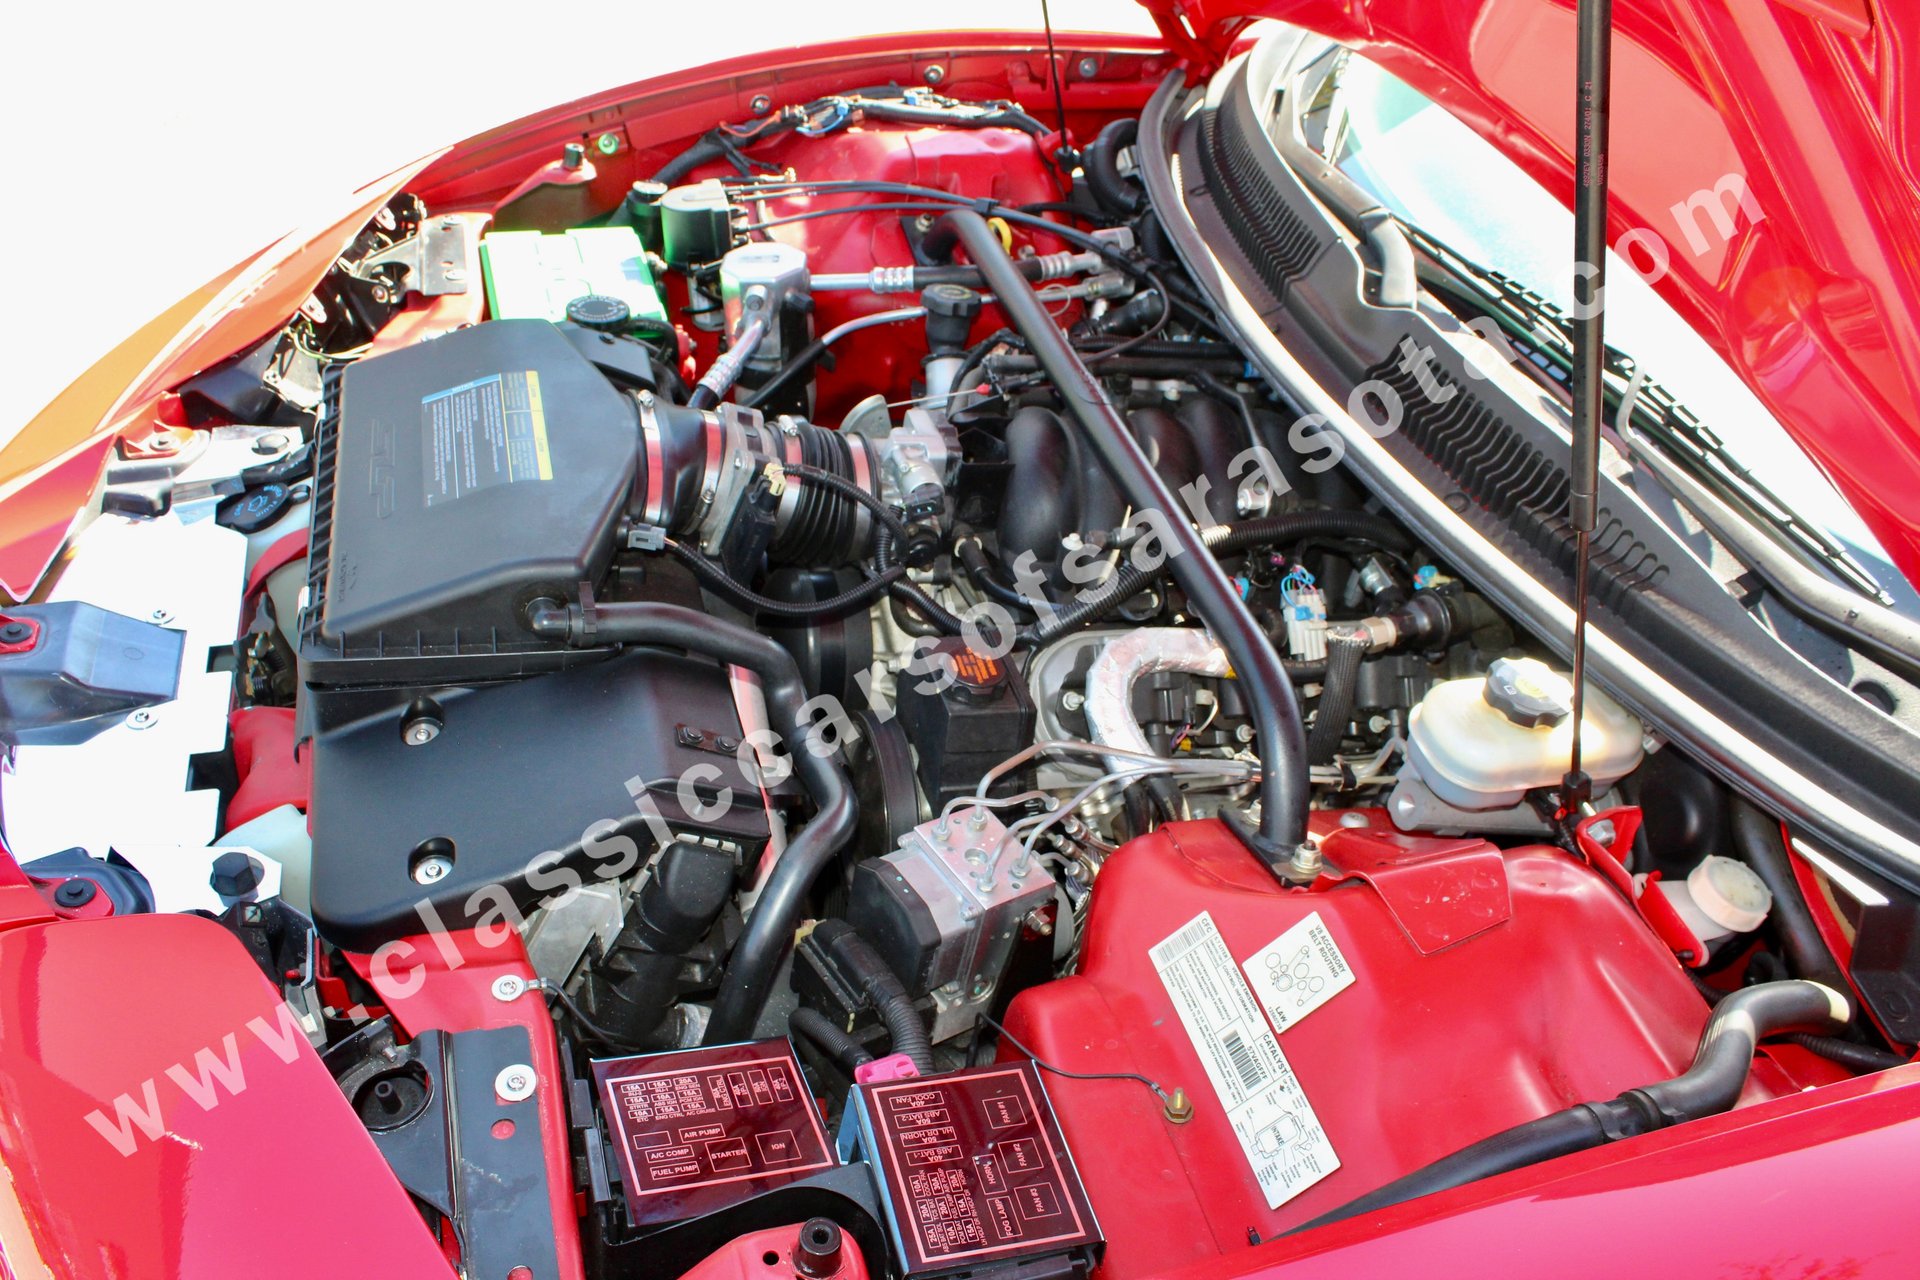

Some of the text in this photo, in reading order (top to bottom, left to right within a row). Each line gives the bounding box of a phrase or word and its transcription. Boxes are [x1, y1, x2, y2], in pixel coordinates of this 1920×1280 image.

[1201, 918, 1212, 933] CFC
[1218, 945, 1228, 958] LITER
[1309, 929, 1339, 978] BELT ROUTING
[1315, 925, 1345, 972] V8 ACCESSORY
[1223, 965, 1255, 1023] CONTROL INFORMATION
[1232, 967, 1257, 1012] VEHICLE EMISSION
[1275, 1006, 1287, 1022] LAW
[1263, 1034, 1288, 1074] CATALYST
[912, 1093, 935, 1101] COOL
[924, 1110, 940, 1118] ABS
[997, 1101, 1010, 1123] FAN #1
[699, 1128, 720, 1136] PUMP
[1271, 1126, 1284, 1146] INTAKE
[666, 1148, 689, 1156] COMP
[711, 1148, 746, 1159] STARTER
[1013, 1143, 1027, 1166] FAN #2
[653, 1164, 697, 1176] FUEL PUMP
[938, 1168, 946, 1183] PUMP
[958, 1169, 966, 1185] HORN
[983, 1163, 995, 1184] HORN
[913, 1180, 921, 1192] 10A
[950, 1174, 959, 1187] 20A
[923, 1181, 931, 1196] COOL
[958, 1199, 966, 1212] 15A
[1030, 1188, 1044, 1212] FAN #3
[920, 1204, 929, 1217] 20A
[939, 1201, 948, 1215] 20A
[995, 1197, 1013, 1237] FOG LAMP
[928, 1229, 937, 1242] 25A
[947, 1226, 956, 1239] 10A
[954, 1220, 966, 1244] PCM BAT
[966, 1224, 975, 1237] 15A
